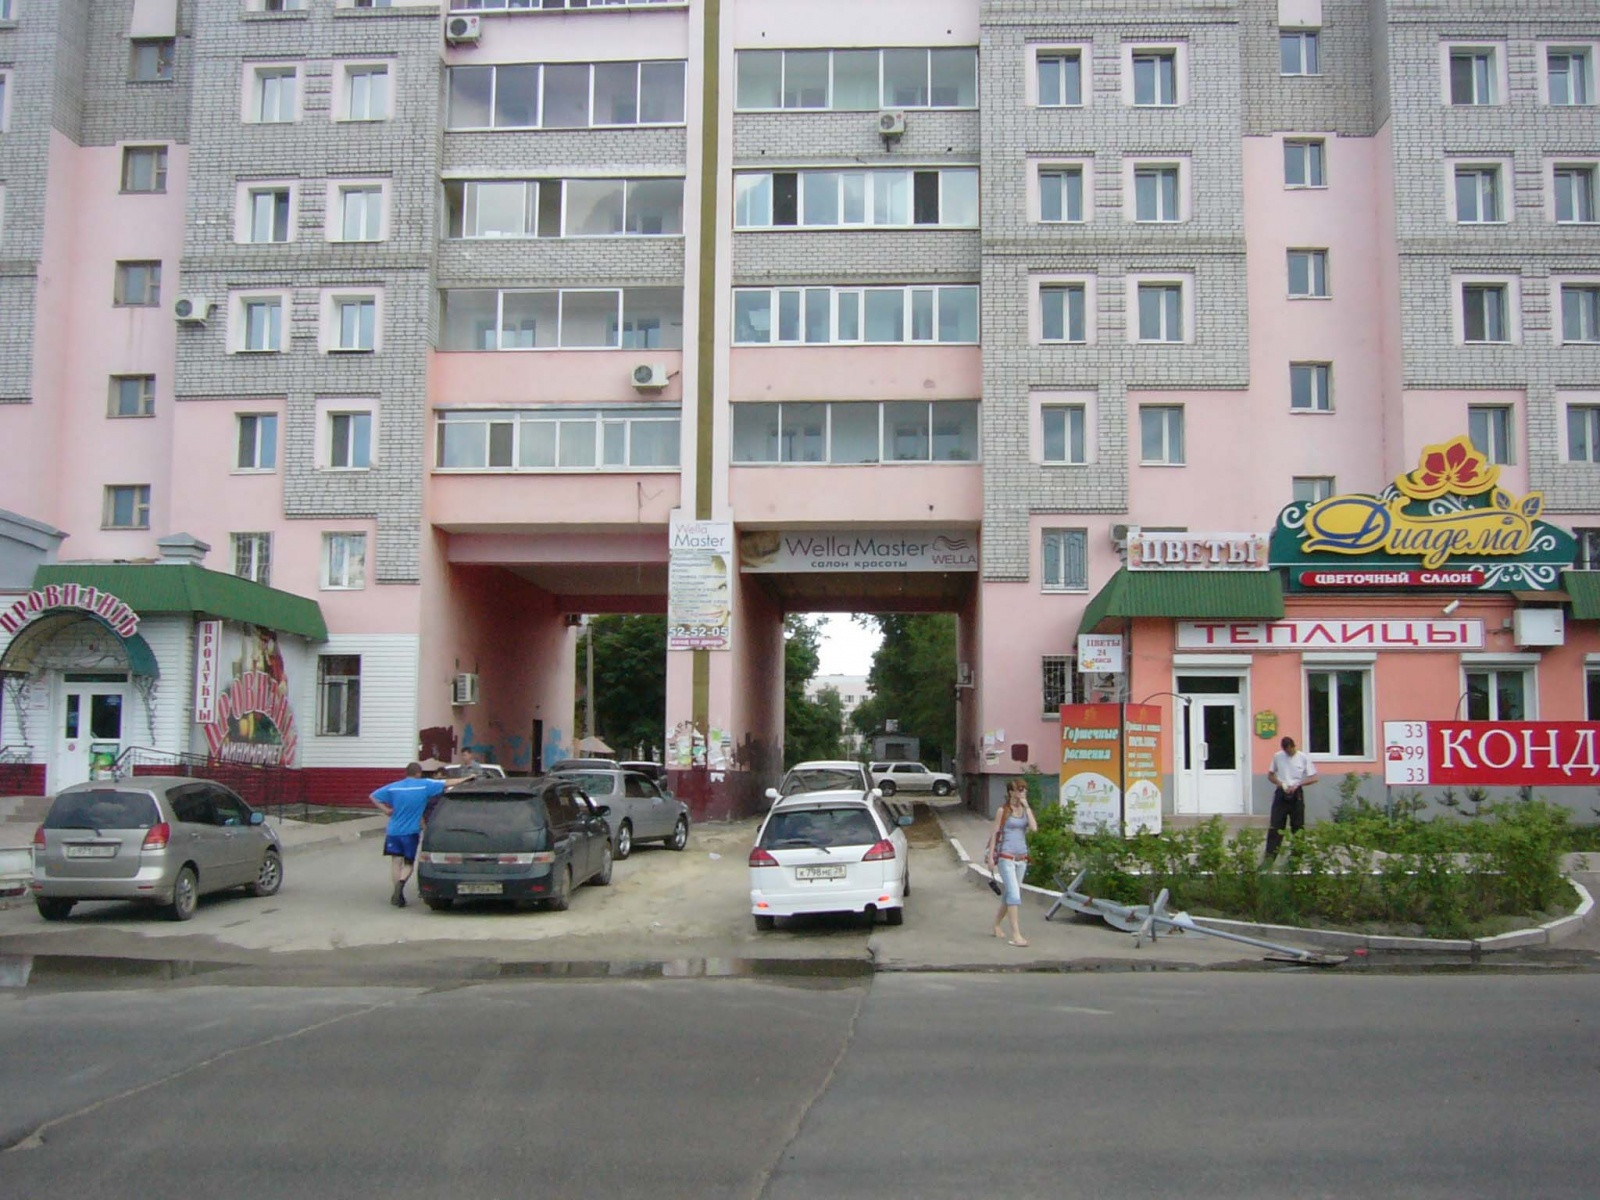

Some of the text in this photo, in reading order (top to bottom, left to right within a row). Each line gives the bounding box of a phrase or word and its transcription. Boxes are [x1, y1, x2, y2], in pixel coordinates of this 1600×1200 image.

[1307, 499, 1526, 565] Диадема
[675, 534, 725, 547] Master
[932, 554, 977, 565] WELLA
[1141, 540, 1257, 565] ЦВЕТЫ
[811, 560, 908, 570] салон красоты
[1315, 572, 1472, 584] ЦВЕТОЧНЫЙ САЛОН
[1194, 623, 1468, 645] ТЕПЛИЦЫ
[1087, 639, 1120, 647] ЦВЕТЫ
[1063, 726, 1119, 743] Горшечные
[1405, 724, 1424, 738] 33
[1063, 747, 1112, 763] растения
[1405, 746, 1424, 760] 99
[1407, 768, 1425, 782] 33
